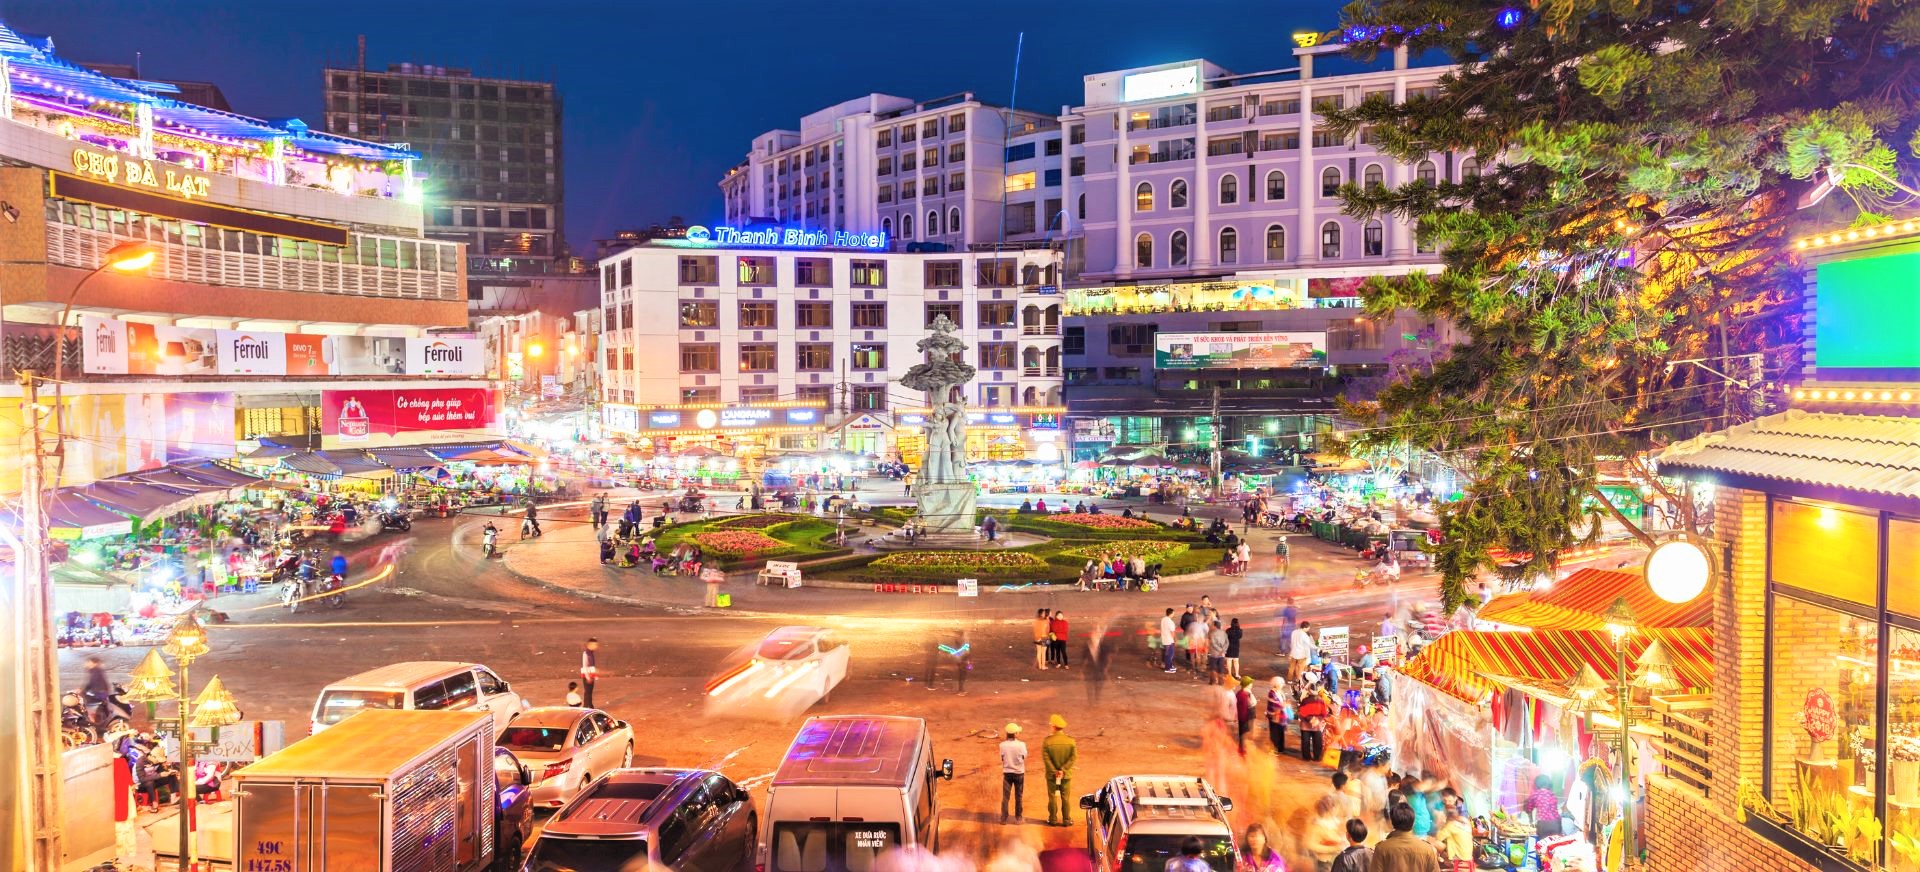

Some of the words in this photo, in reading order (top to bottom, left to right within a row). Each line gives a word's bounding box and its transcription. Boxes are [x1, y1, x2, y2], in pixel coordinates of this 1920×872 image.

[73, 149, 119, 183] CHỢ
[125, 160, 159, 187] ĐÀ
[166, 170, 210, 199] LẠT
[715, 227, 778, 244] Thanh
[833, 231, 886, 248] Hotel
[96, 328, 116, 357] Ferroli
[234, 340, 269, 362] Ferroli
[425, 346, 463, 364] Ferroli
[340, 420, 367, 429] Neptune
[349, 427, 366, 435] Gold
[1809, 706, 1830, 719] HAPPY
[256, 840, 283, 855] 49C
[857, 839, 871, 848] NHÂN
[871, 839, 884, 848] VIÊN
[248, 858, 291, 872] 147.58
